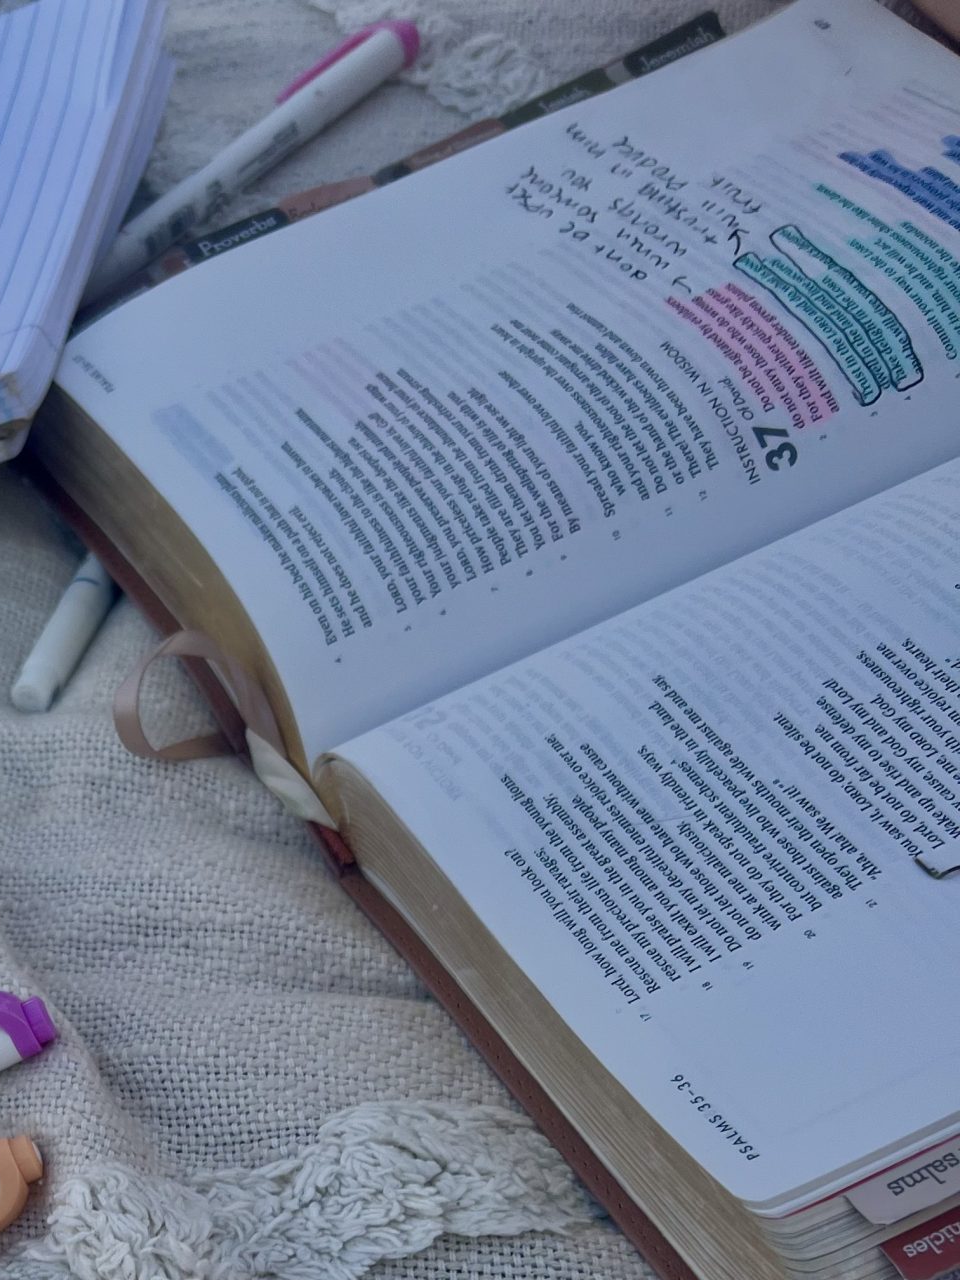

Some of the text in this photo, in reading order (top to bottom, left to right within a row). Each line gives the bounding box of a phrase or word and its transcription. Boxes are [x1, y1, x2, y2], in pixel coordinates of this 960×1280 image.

[197, 210, 278, 258] Proverbs
[714, 315, 730, 328] do
[725, 325, 747, 346] who
[742, 342, 769, 369] those
[717, 374, 755, 421] Of David.
[762, 367, 786, 393] envy
[778, 390, 798, 414] not
[531, 402, 553, 423] love
[658, 339, 761, 485] INSTRUCTION IN WISDOM
[790, 412, 806, 430] do
[543, 418, 578, 454] faithful
[573, 419, 627, 497] who know you,
[751, 426, 798, 471] 37
[571, 451, 594, 478] your
[585, 475, 616, 519] Spread
[636, 743, 804, 922] For they do not speak in friendly ways,
[499, 773, 682, 983] rescue my precious life from the young lions.
[503, 847, 641, 1005] Lord, how long will you look on?
[532, 846, 662, 995] Rescue me from their ravages;
[708, 1114, 760, 1161] PSALMS
[887, 1149, 960, 1197] salms
